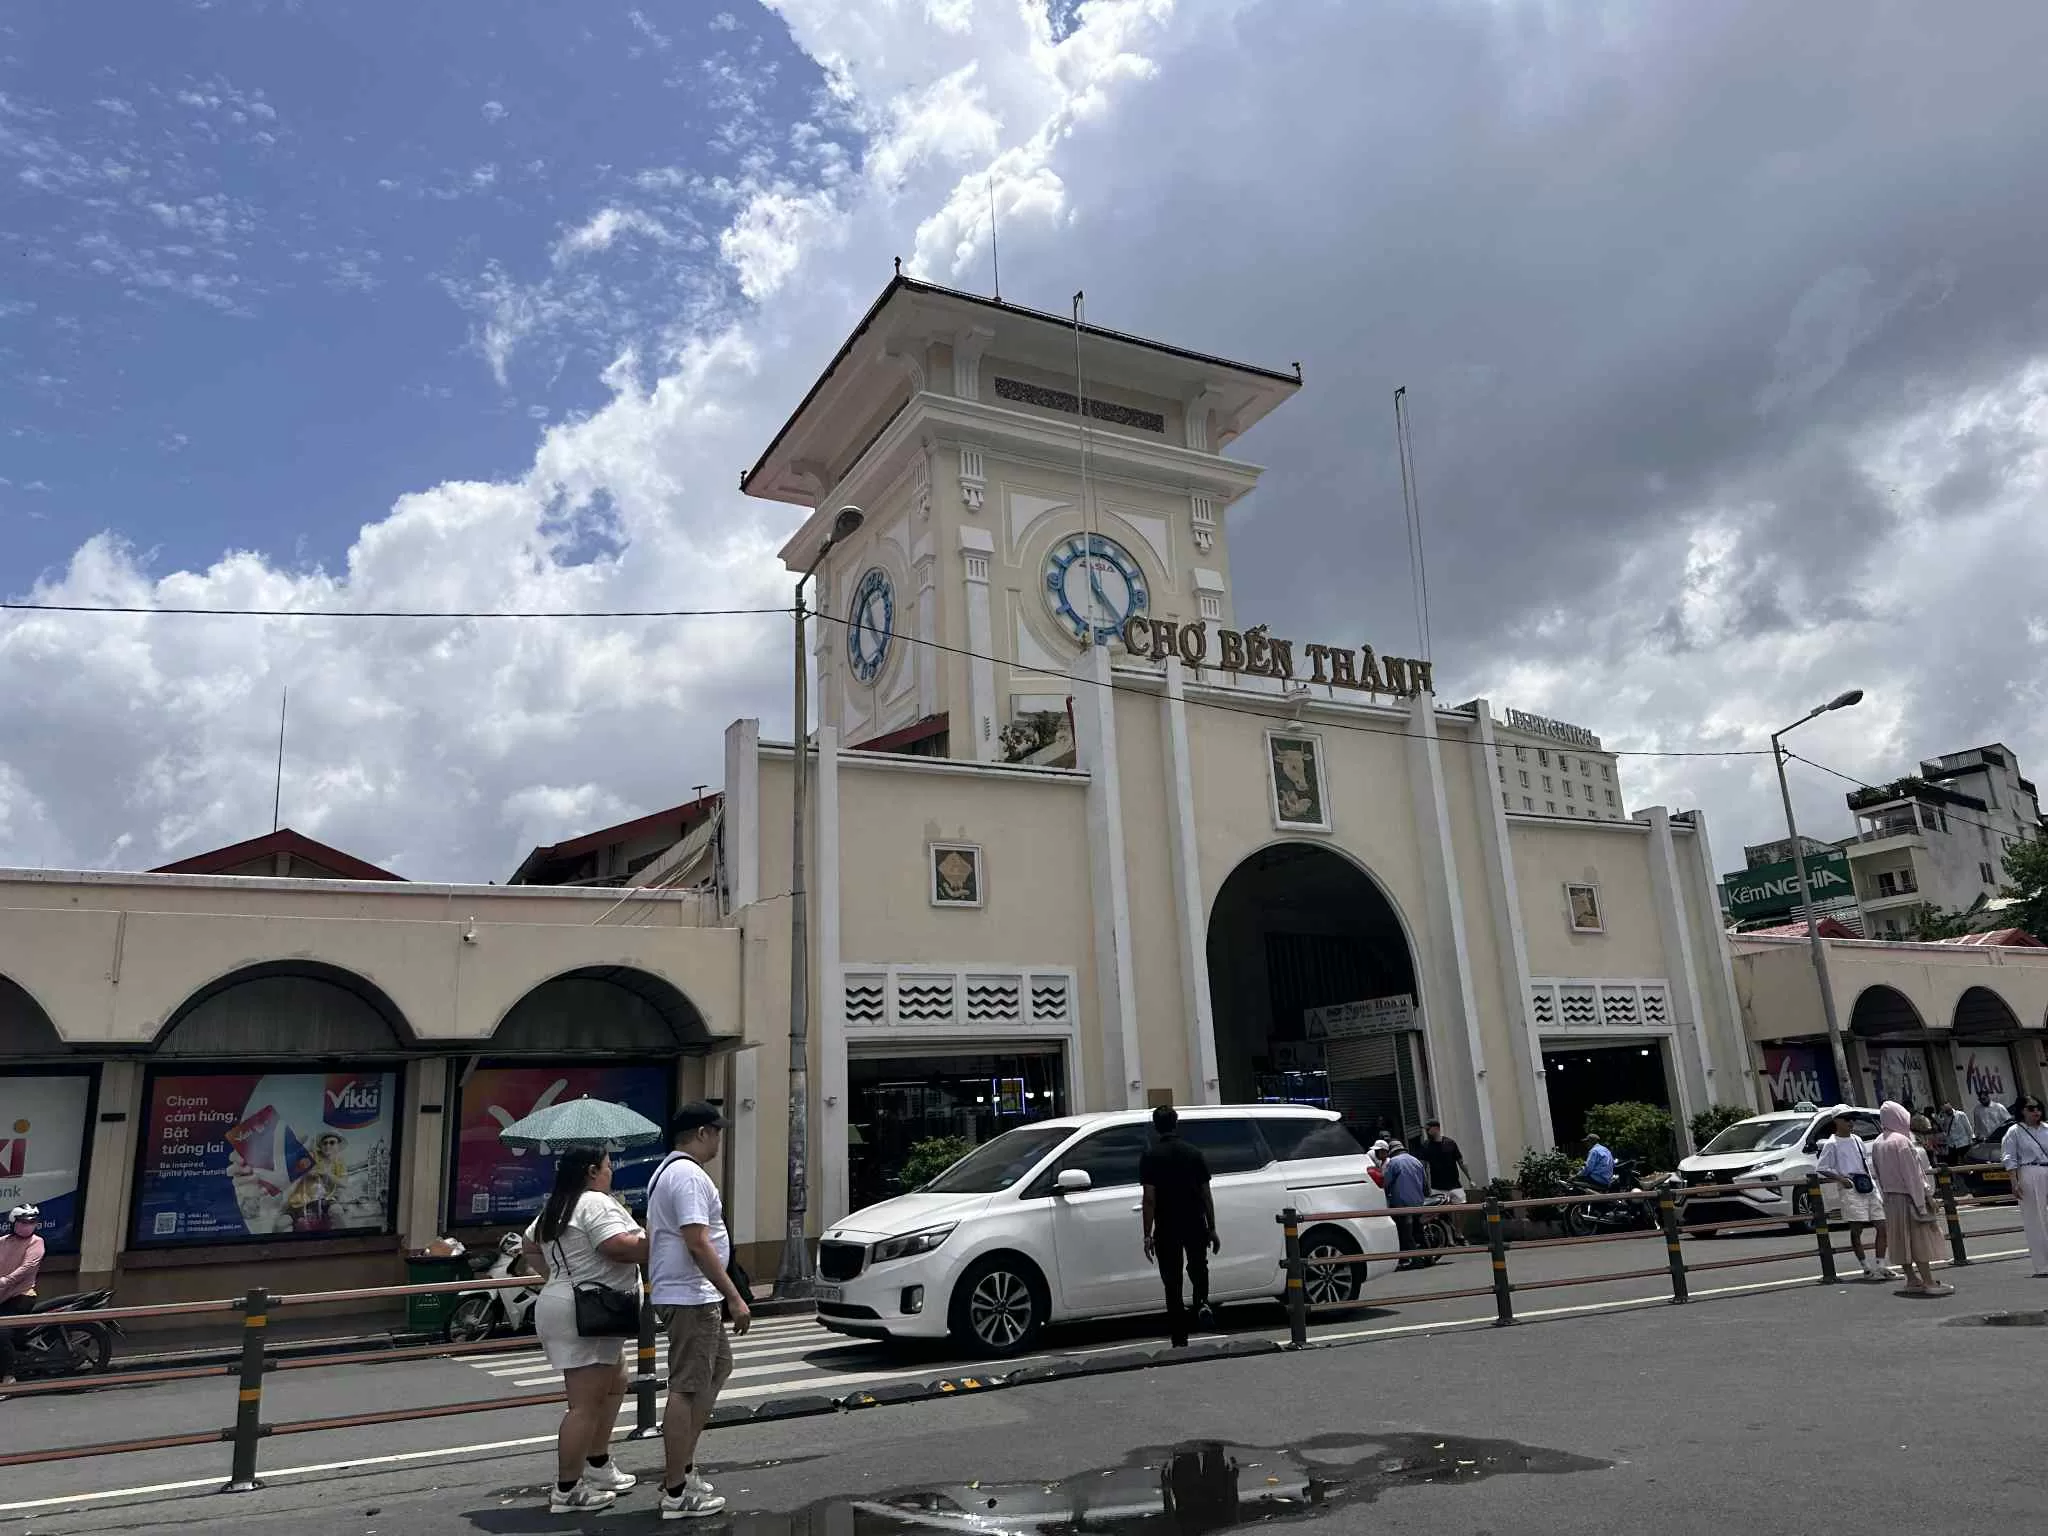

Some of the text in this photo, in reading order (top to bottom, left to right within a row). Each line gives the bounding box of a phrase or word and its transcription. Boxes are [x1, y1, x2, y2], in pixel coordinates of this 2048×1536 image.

[1124, 615, 1436, 697] CHỢ BẾN THÀNH
[1768, 1056, 1823, 1103] Vikki
[166, 1095, 208, 1109] Chạm
[327, 1080, 378, 1109] Vikki
[165, 1109, 238, 1123] cảm hứng.
[163, 1127, 189, 1142] Bật
[162, 1141, 224, 1156] tương lai
[0, 1185, 22, 1199] nk
